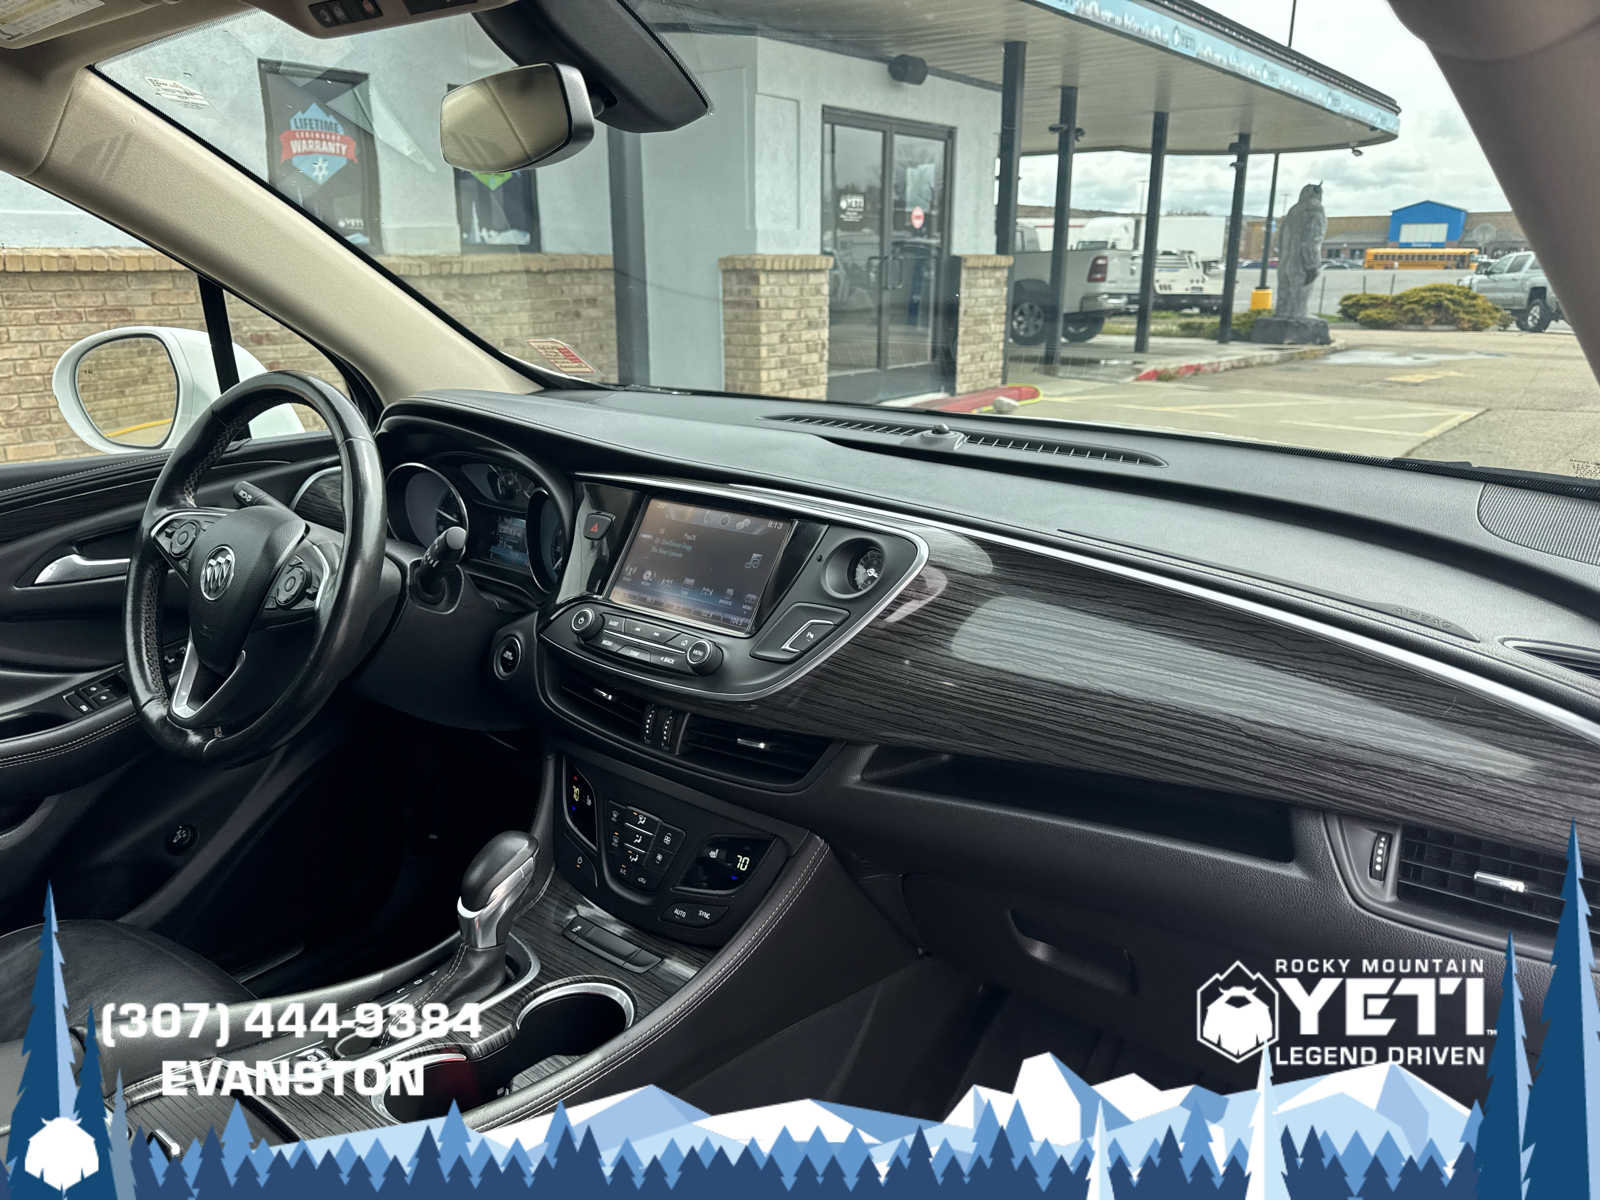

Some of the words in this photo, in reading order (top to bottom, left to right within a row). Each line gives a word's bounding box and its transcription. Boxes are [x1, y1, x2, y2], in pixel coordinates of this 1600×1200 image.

[294, 117, 340, 133] LIFETIME
[290, 140, 348, 156] WARRANTY
[1391, 607, 1453, 629] AIRBAG
[736, 854, 750, 871] 70
[674, 908, 687, 918] AUTO
